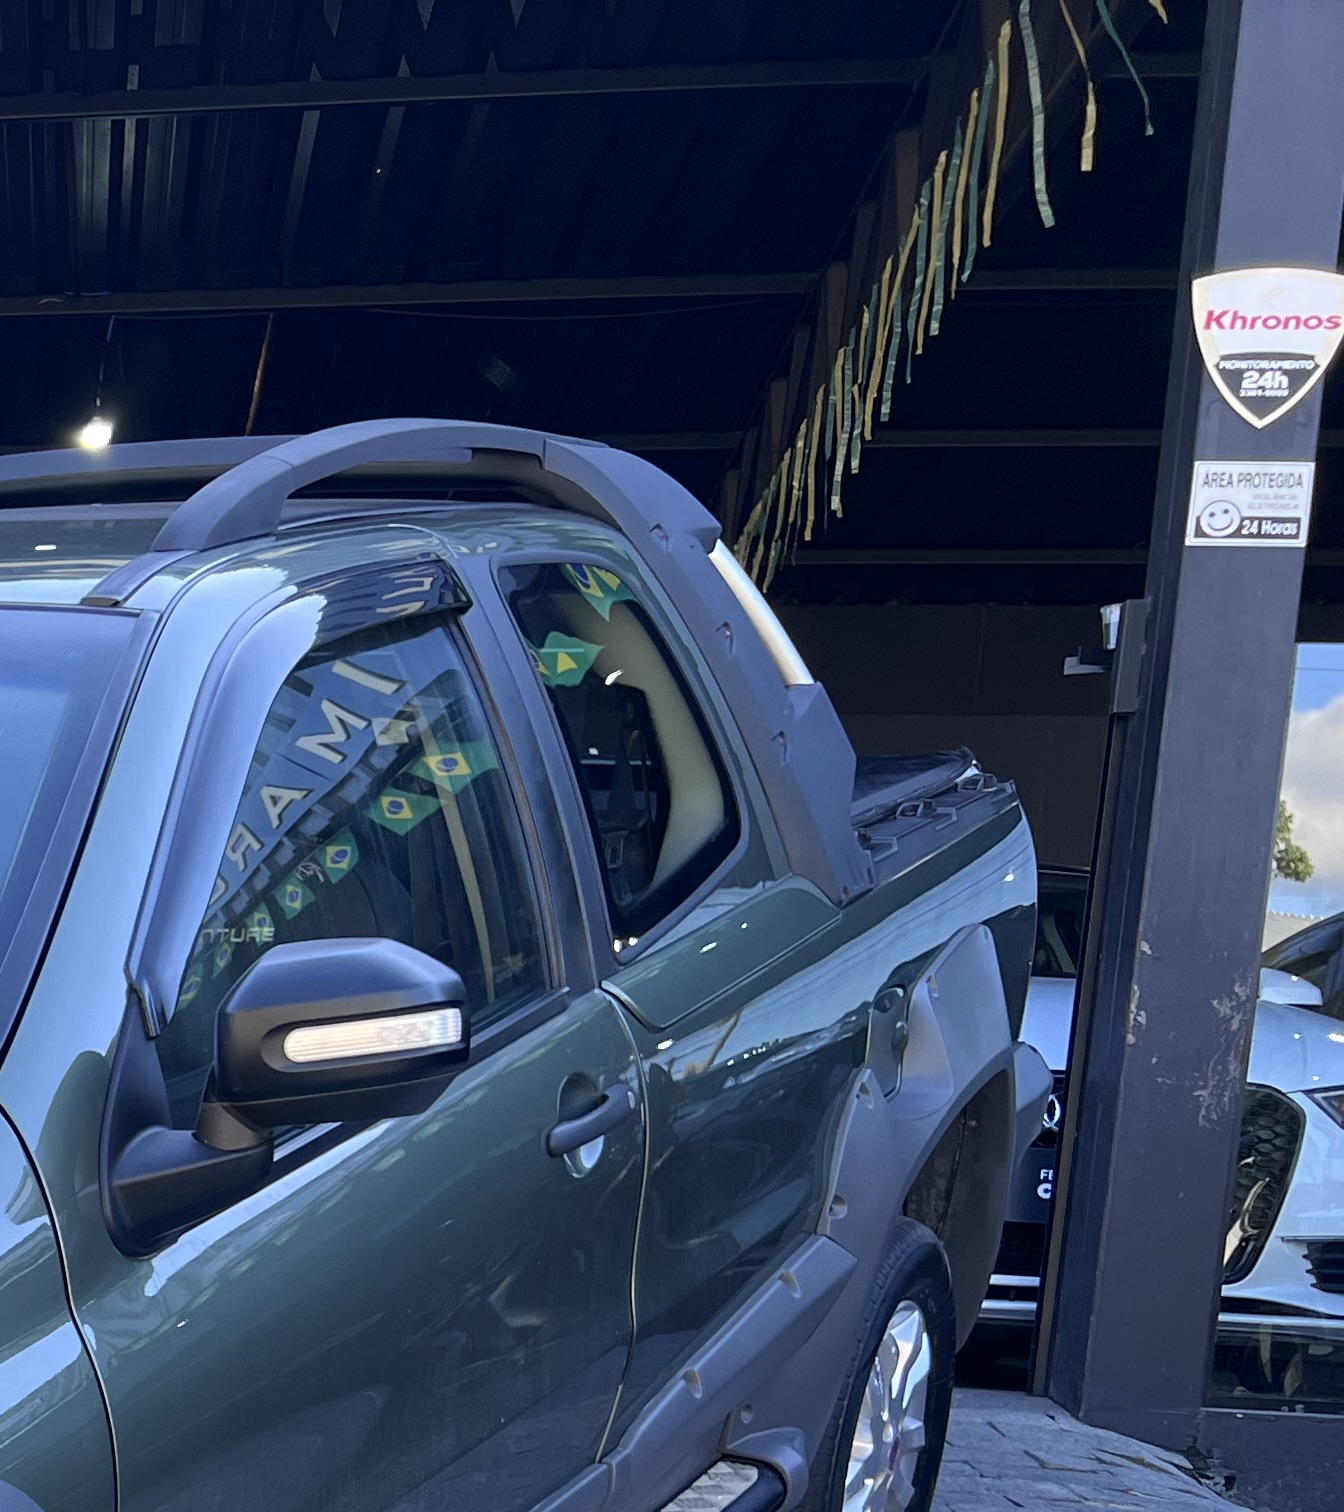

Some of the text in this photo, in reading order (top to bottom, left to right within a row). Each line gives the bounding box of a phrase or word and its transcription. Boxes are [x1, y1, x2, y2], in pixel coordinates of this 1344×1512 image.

[1203, 309, 1342, 331] Khronos
[1241, 370, 1289, 389] 24h
[1202, 471, 1304, 489] ÁREA PROTEGIDA
[1240, 519, 1299, 536] 24 Horas
[199, 927, 276, 943] NTURE
